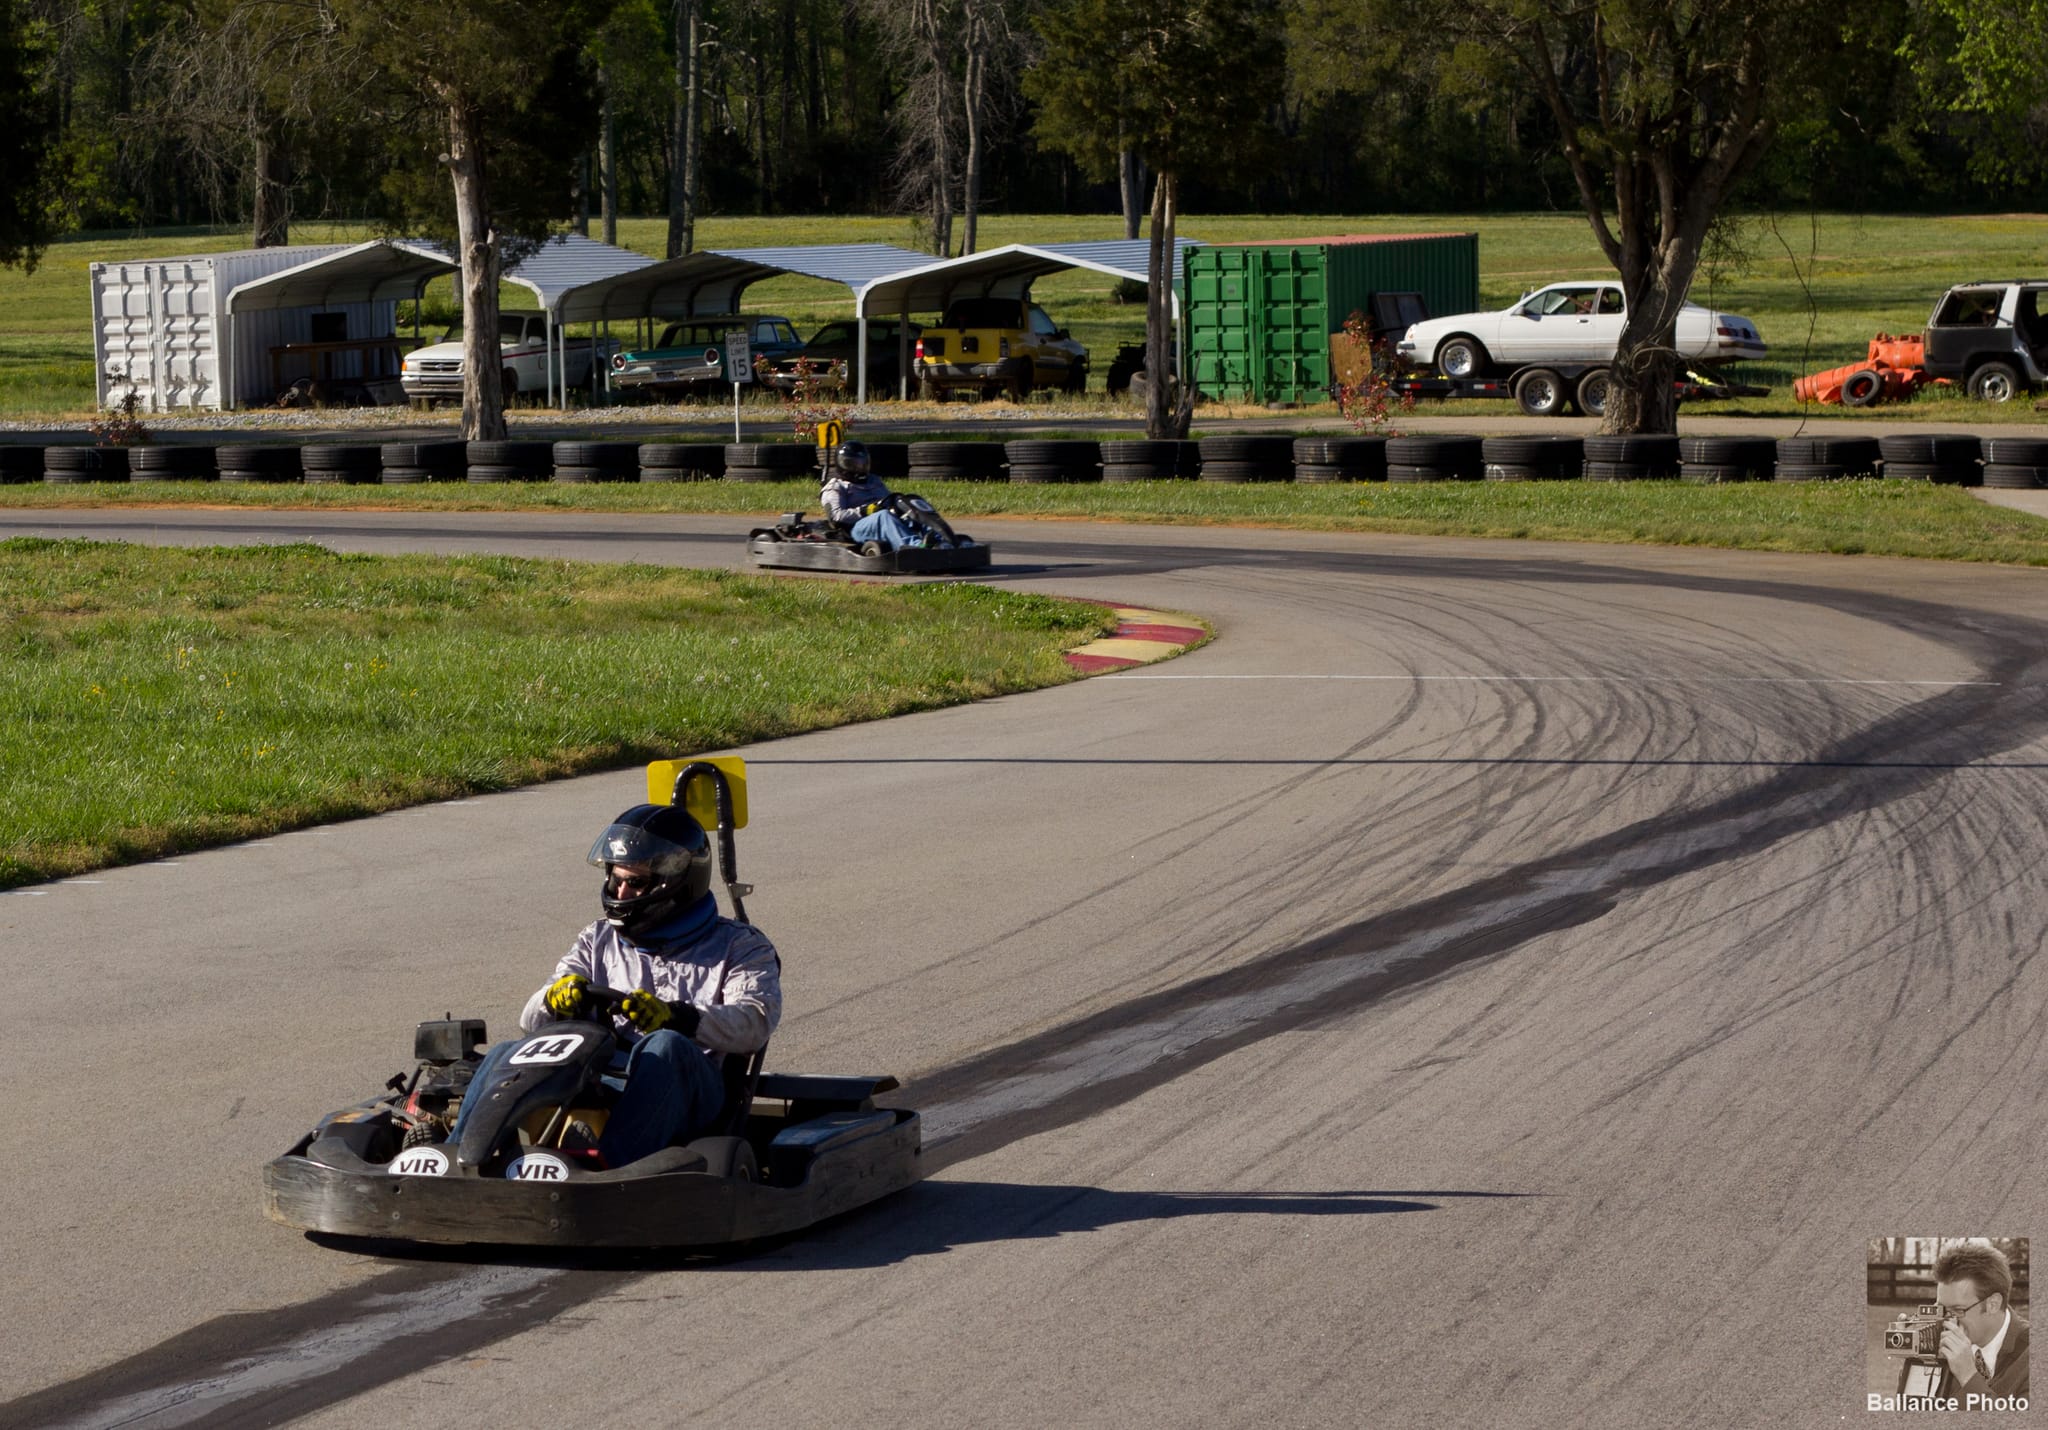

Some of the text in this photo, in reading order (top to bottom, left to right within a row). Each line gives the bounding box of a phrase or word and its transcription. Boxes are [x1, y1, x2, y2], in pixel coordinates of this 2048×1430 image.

[732, 358, 748, 377] 15
[516, 1038, 575, 1058] 44
[399, 1158, 440, 1174] VIR
[515, 1164, 560, 1180] VIR
